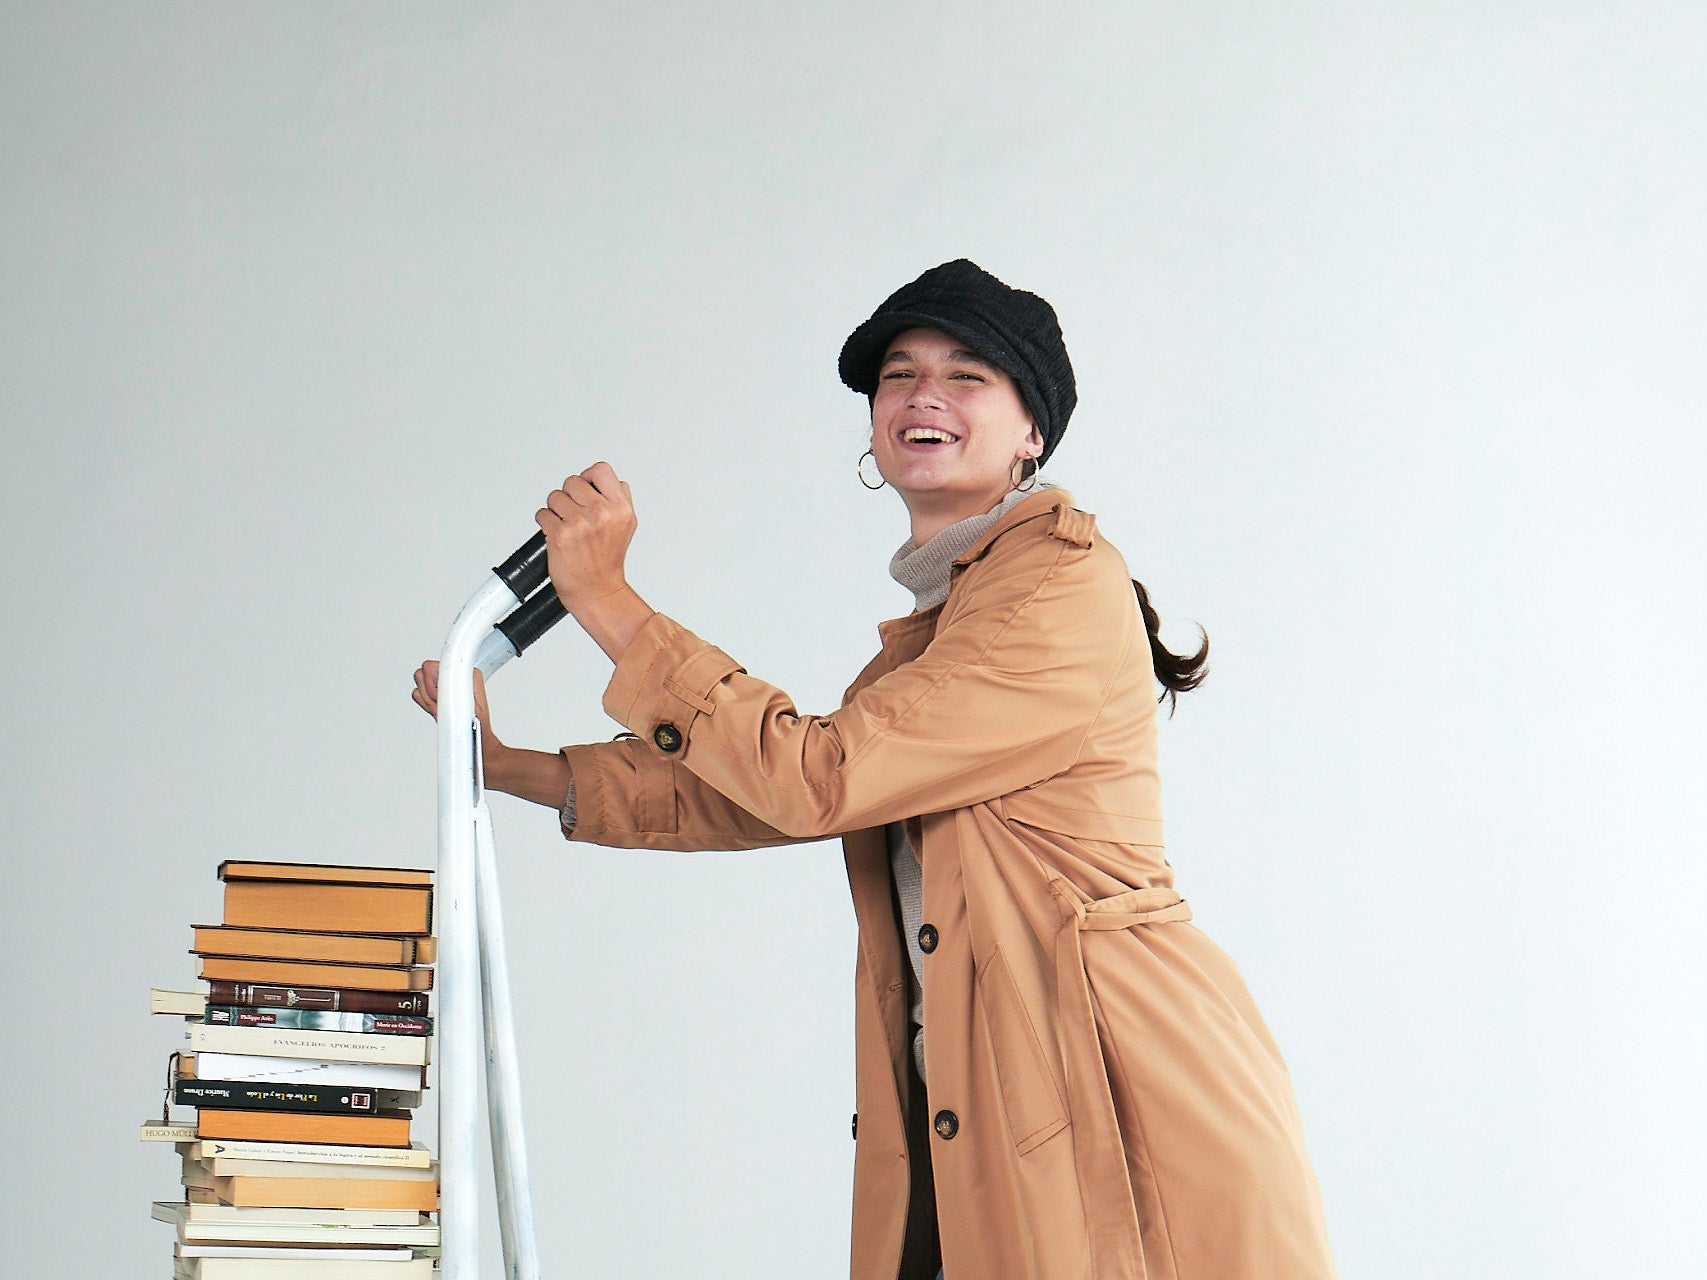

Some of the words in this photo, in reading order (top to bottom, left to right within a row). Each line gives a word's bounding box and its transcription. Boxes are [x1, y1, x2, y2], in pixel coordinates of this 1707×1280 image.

[240, 1014, 260, 1022] Philippe
[274, 1039, 326, 1047] EVANGELIOS
[205, 1089, 230, 1097] Maurice
[308, 1094, 318, 1102] La
